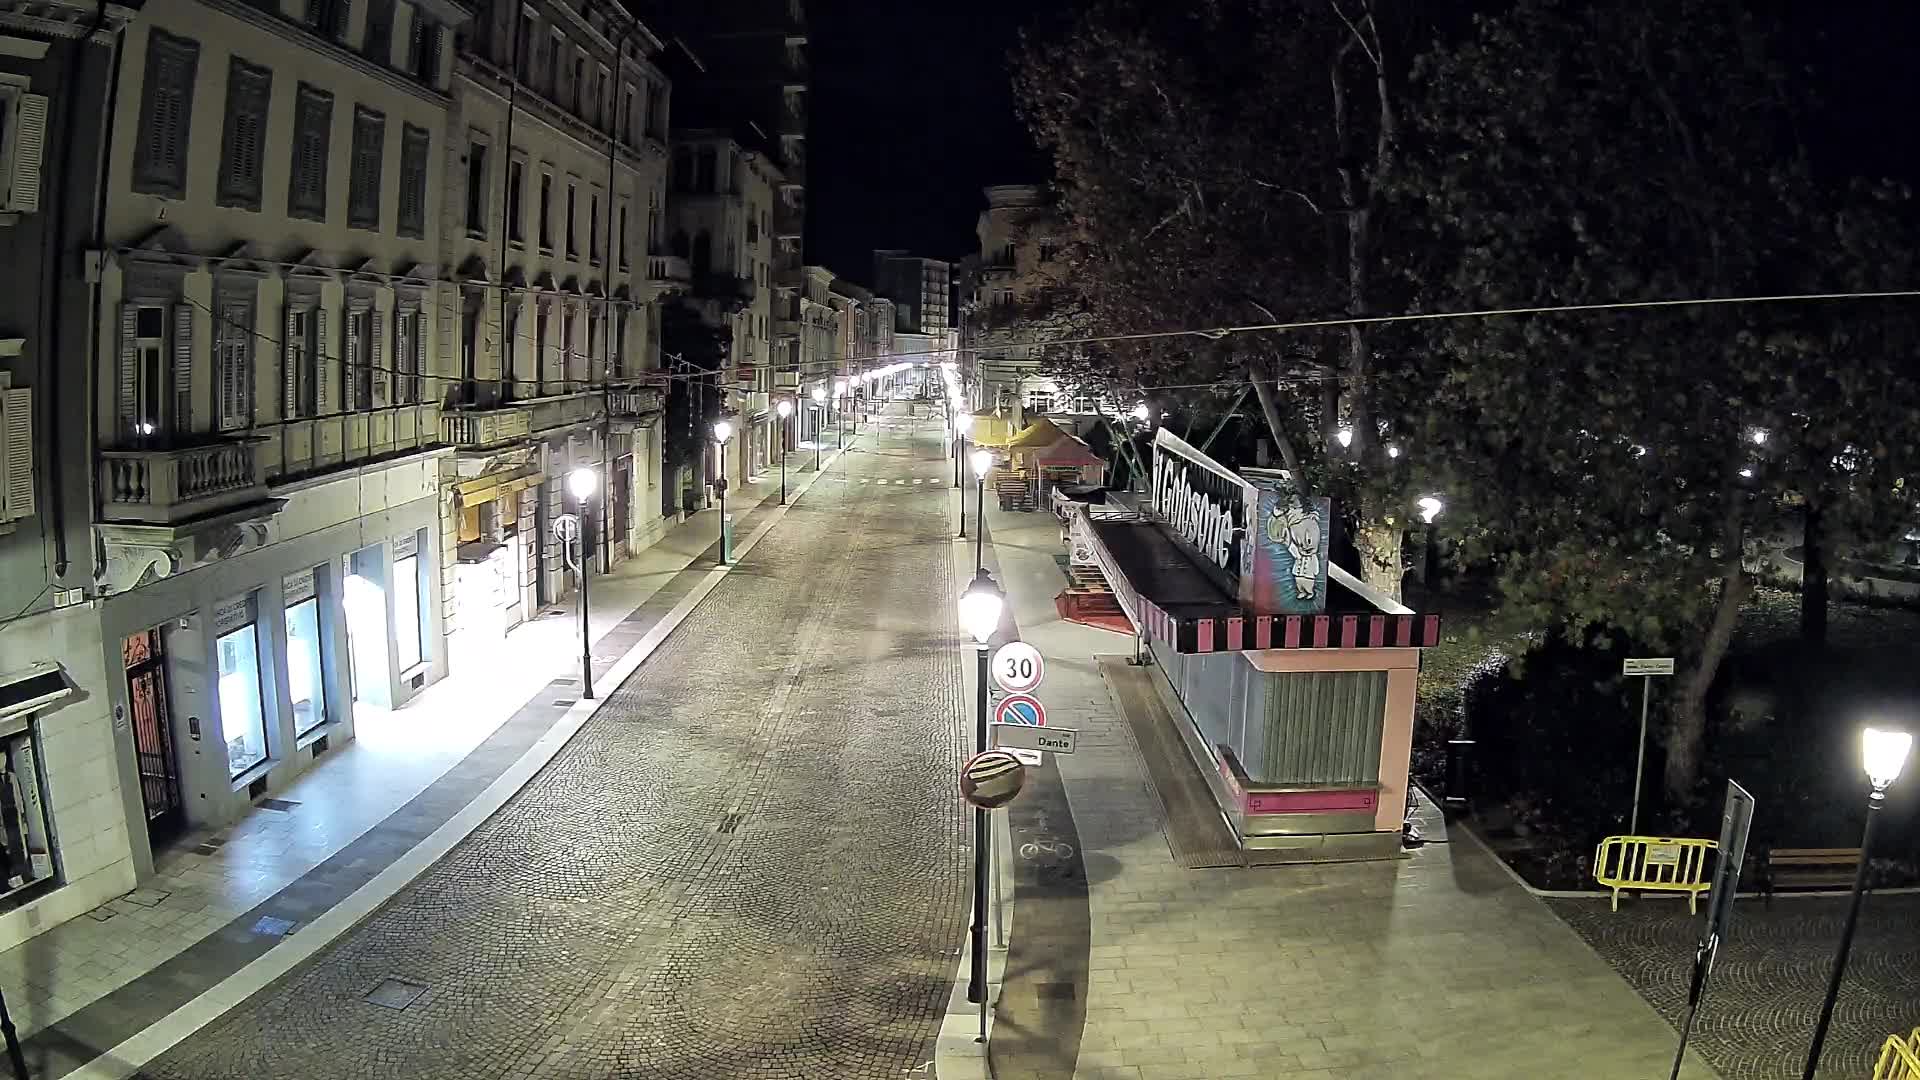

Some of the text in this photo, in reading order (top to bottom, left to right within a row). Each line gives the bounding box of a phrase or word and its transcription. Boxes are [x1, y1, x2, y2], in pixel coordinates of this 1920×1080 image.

[1162, 458, 1233, 569] Golosone
[1006, 658, 1031, 678] 30
[1038, 737, 1069, 748] Dante
